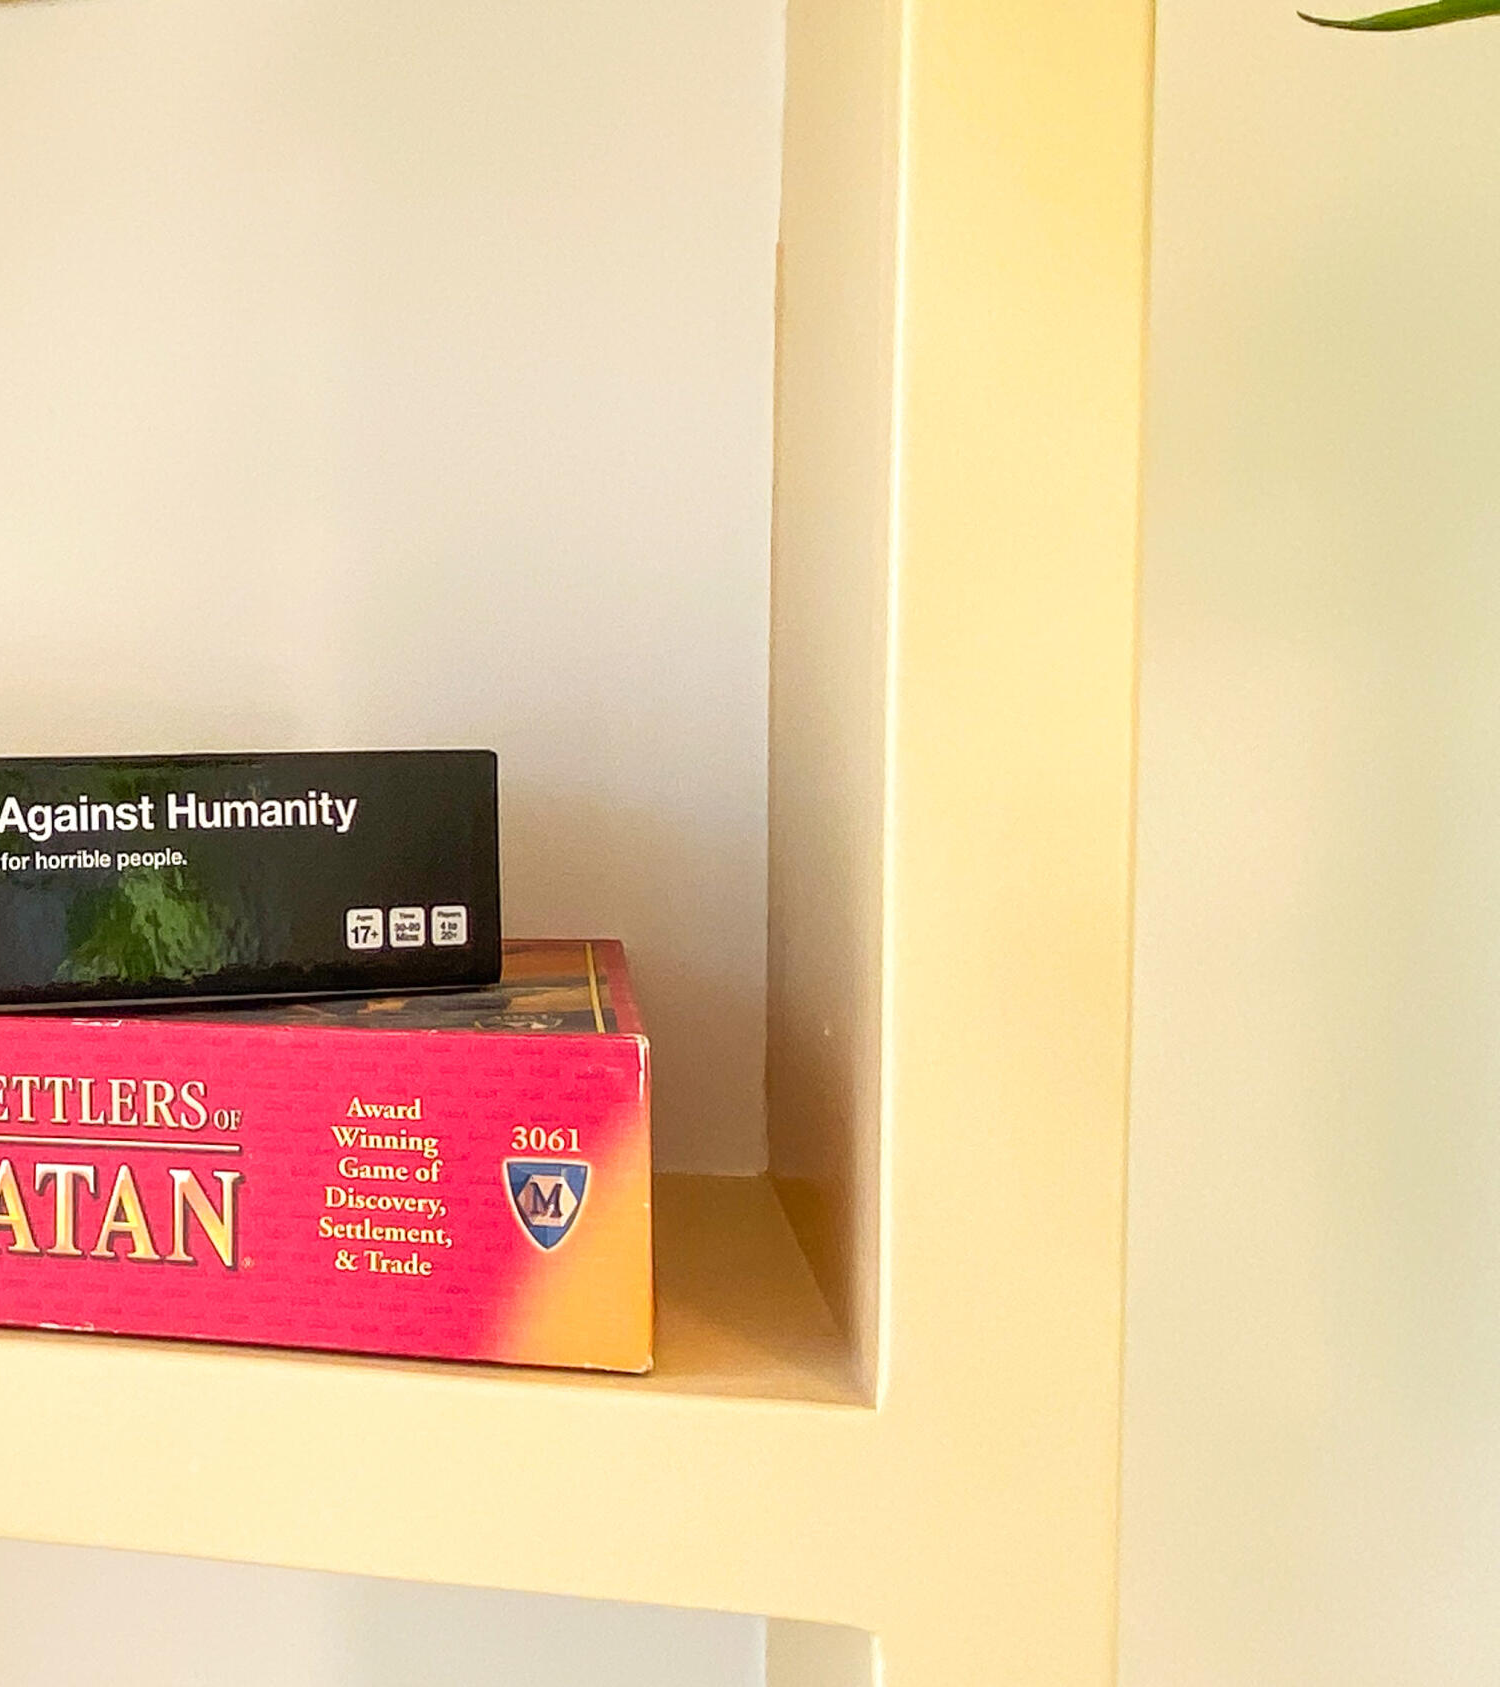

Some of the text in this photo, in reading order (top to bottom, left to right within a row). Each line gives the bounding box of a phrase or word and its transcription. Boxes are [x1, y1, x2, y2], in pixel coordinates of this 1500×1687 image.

[167, 790, 357, 834] Humanity
[0, 852, 30, 871] for
[35, 850, 112, 870] horrible
[117, 847, 188, 871] people.
[351, 925, 379, 944] 17+
[213, 1109, 243, 1131] OF
[347, 1097, 422, 1121] Award
[331, 1125, 439, 1157] Winning
[511, 1126, 582, 1152] 3061
[338, 1157, 444, 1183] Game of
[325, 1186, 447, 1219] Discovery,
[531, 1182, 564, 1218] M
[319, 1217, 453, 1248] Settlement,
[335, 1250, 433, 1276] & Trade
